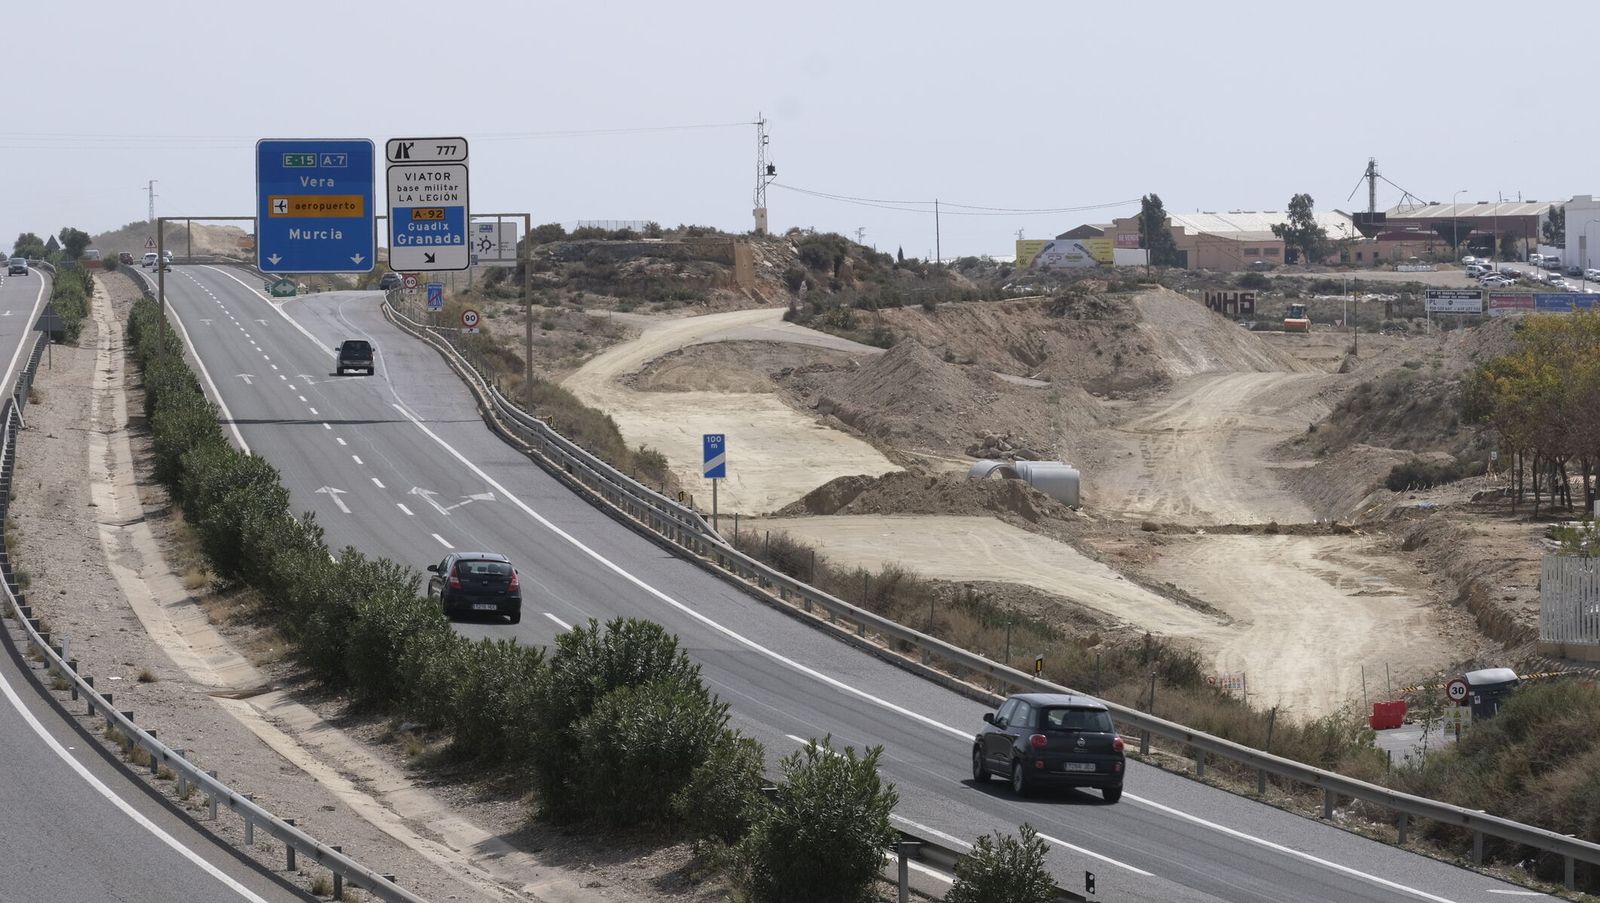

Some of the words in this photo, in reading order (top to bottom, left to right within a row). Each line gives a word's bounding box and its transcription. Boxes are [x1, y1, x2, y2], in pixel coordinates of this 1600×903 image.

[436, 146, 456, 155] 777
[285, 155, 315, 166] E-15
[323, 155, 345, 166] A-7
[300, 176, 335, 188] Vera
[405, 172, 451, 181] VIATOR
[397, 184, 420, 192] base
[424, 183, 459, 192] militar
[399, 193, 414, 202] LA
[419, 191, 458, 202] LEGIÓN
[294, 201, 356, 212] aeropuerto
[414, 209, 443, 219] A-92
[408, 221, 449, 231] Guadix
[289, 228, 343, 240] Murcia
[397, 233, 461, 244] Granada
[1205, 292, 1255, 314] WHS
[706, 435, 722, 443] 100
[1451, 686, 1465, 695] 30
